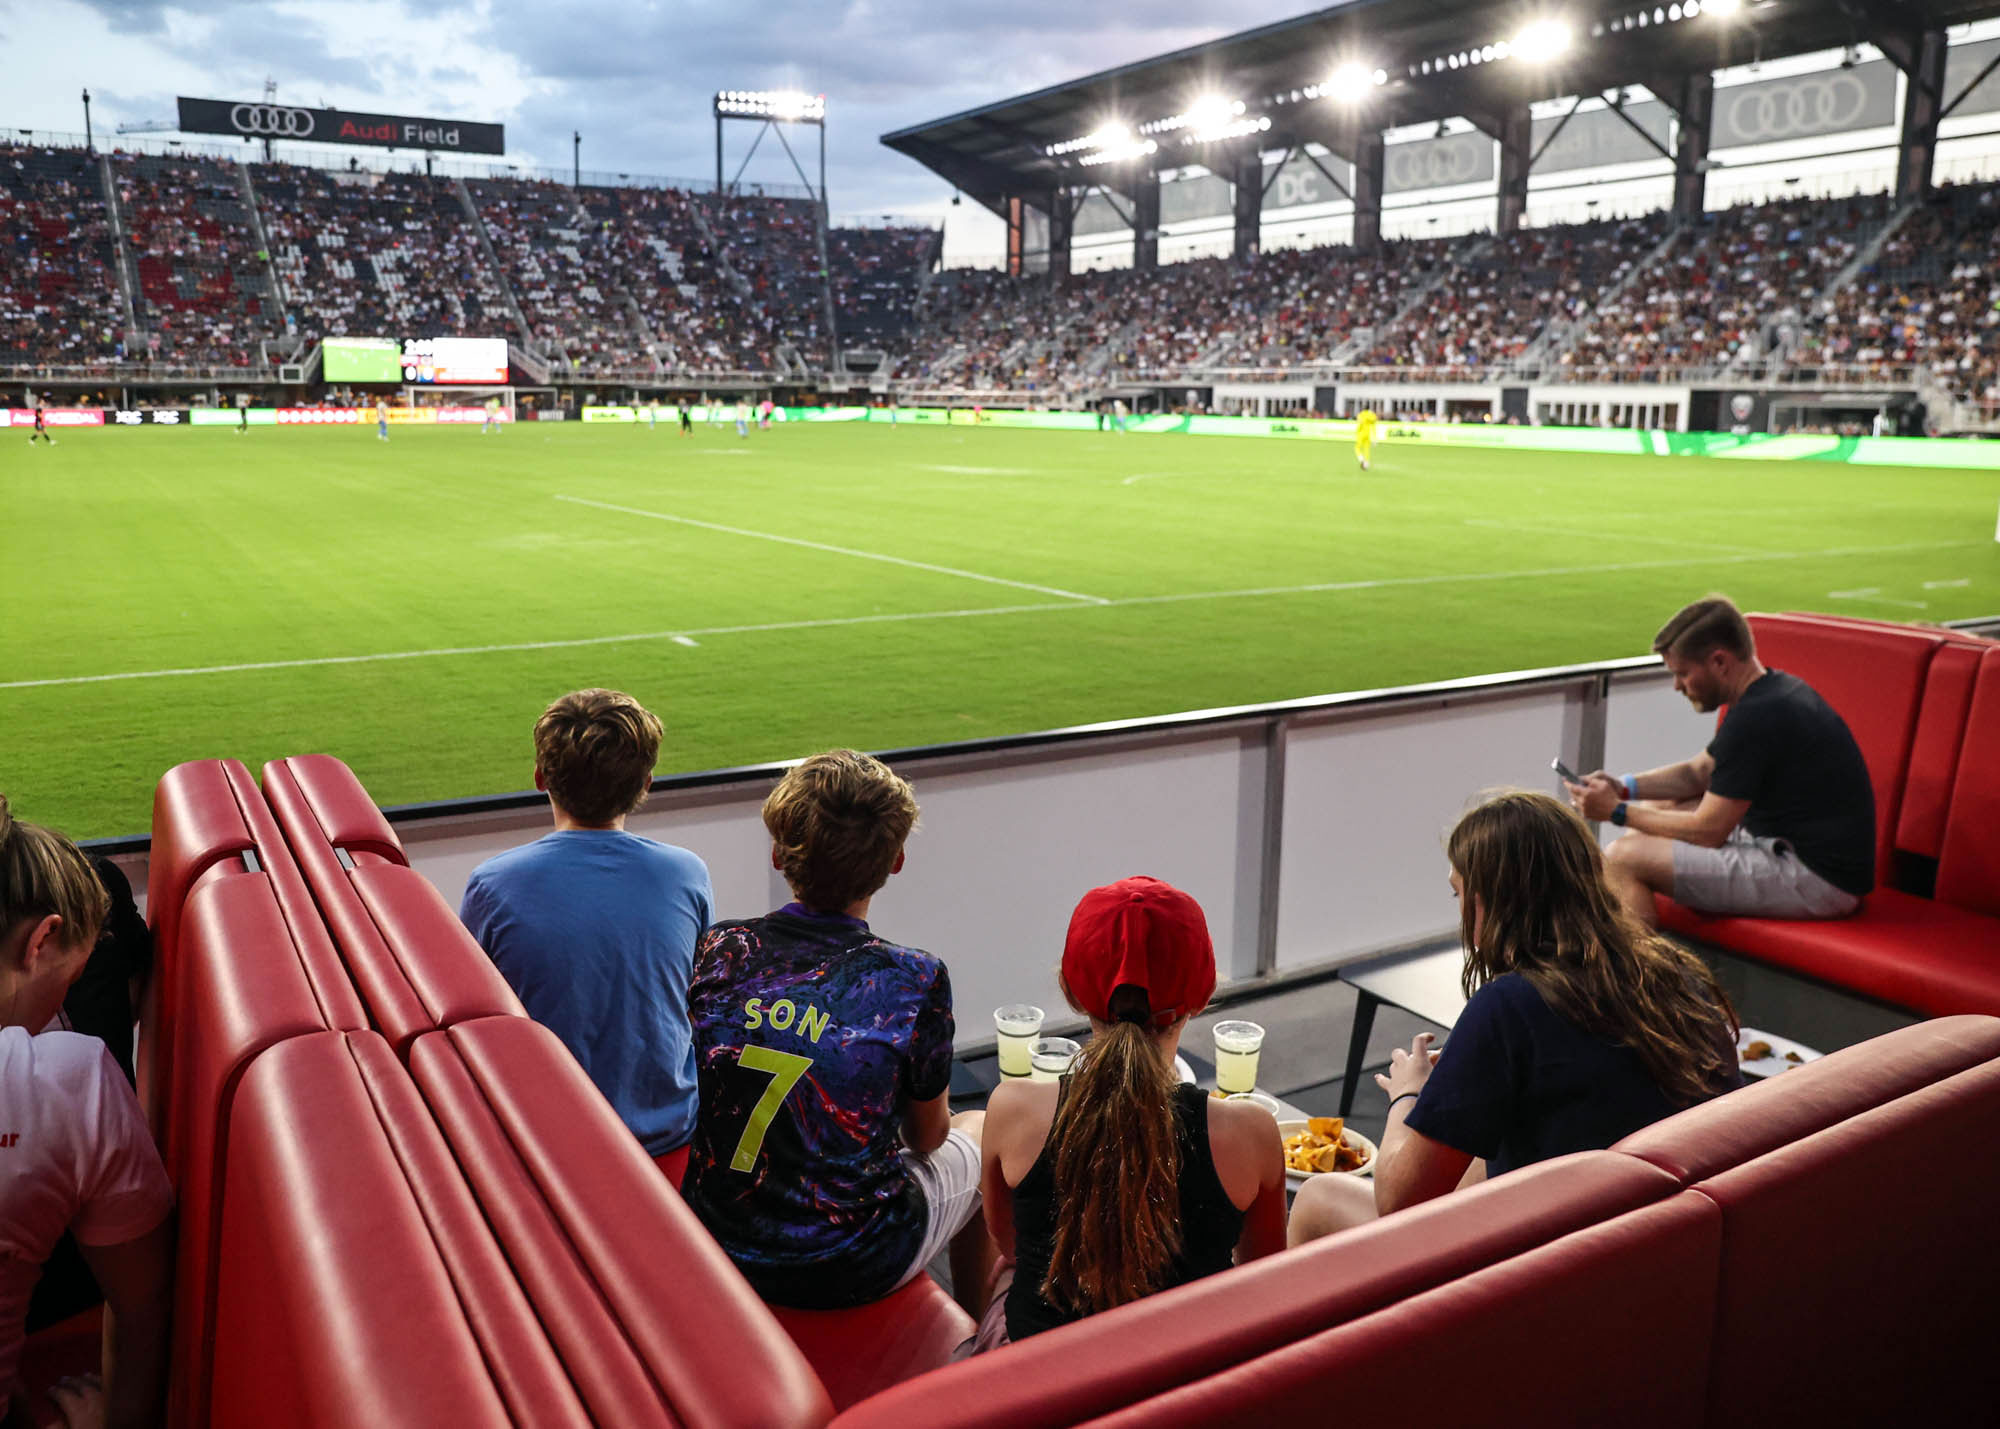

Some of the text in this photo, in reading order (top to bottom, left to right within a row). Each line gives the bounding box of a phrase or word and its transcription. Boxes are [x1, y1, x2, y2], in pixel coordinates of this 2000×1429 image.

[340, 120, 460, 146] Audi Field
[1278, 171, 1319, 206] DC
[744, 998, 831, 1044] SON
[729, 1043, 814, 1173] 7
